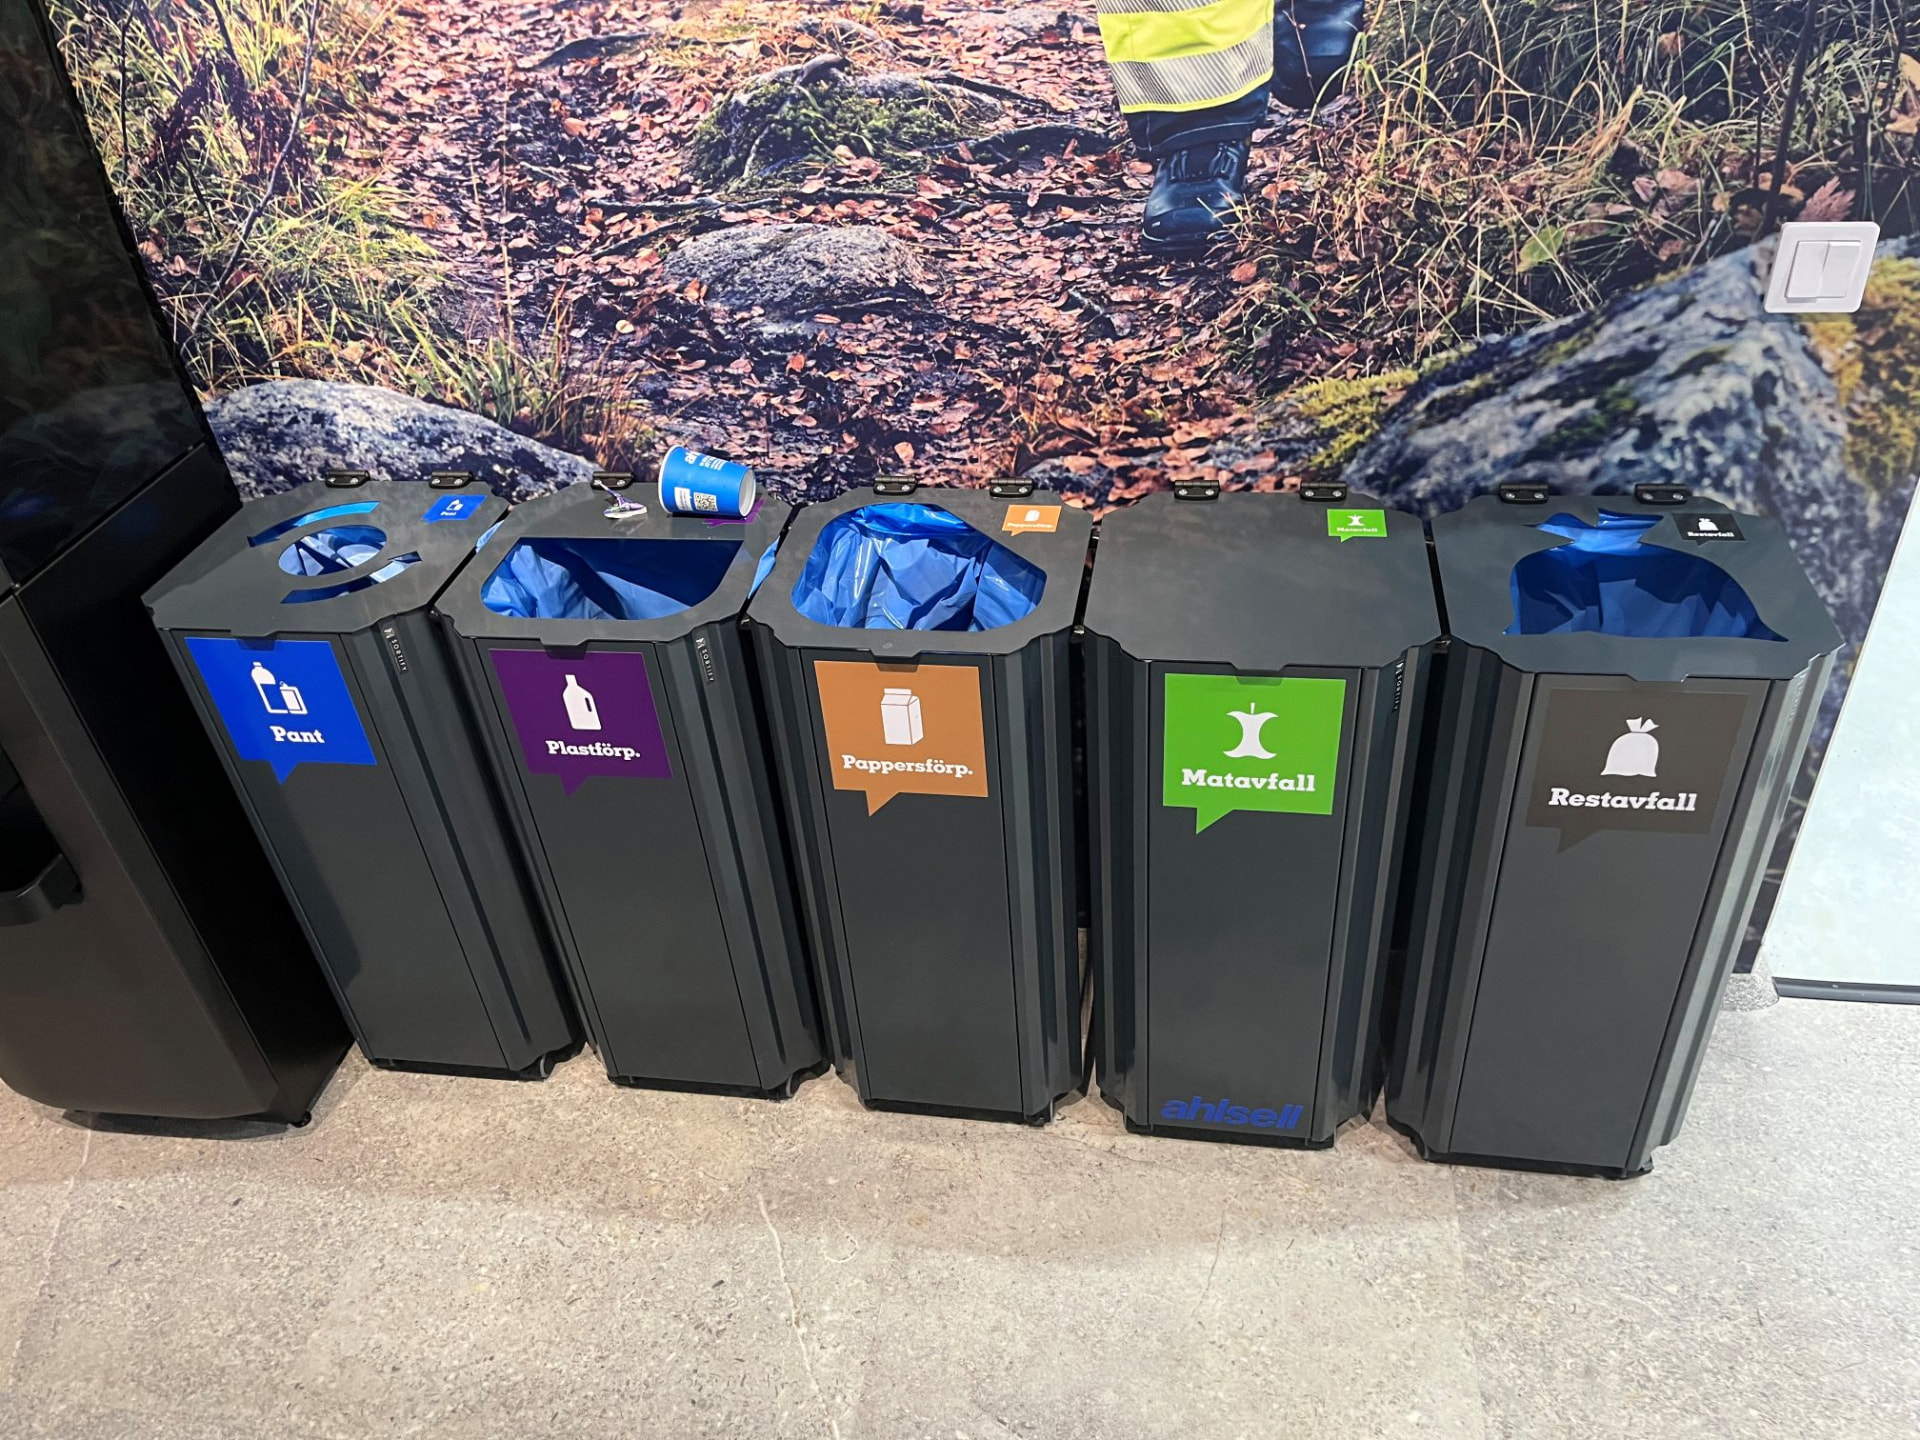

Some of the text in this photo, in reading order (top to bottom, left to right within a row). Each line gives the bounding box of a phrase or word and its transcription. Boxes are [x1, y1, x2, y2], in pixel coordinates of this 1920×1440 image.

[269, 725, 325, 743] Pant
[545, 740, 641, 760] Plastförp.
[841, 754, 973, 778] Pappersförp.
[1181, 768, 1316, 792] Matavfall
[1548, 787, 1698, 812] Restavfall
[1160, 1096, 1304, 1130] ahlsell
